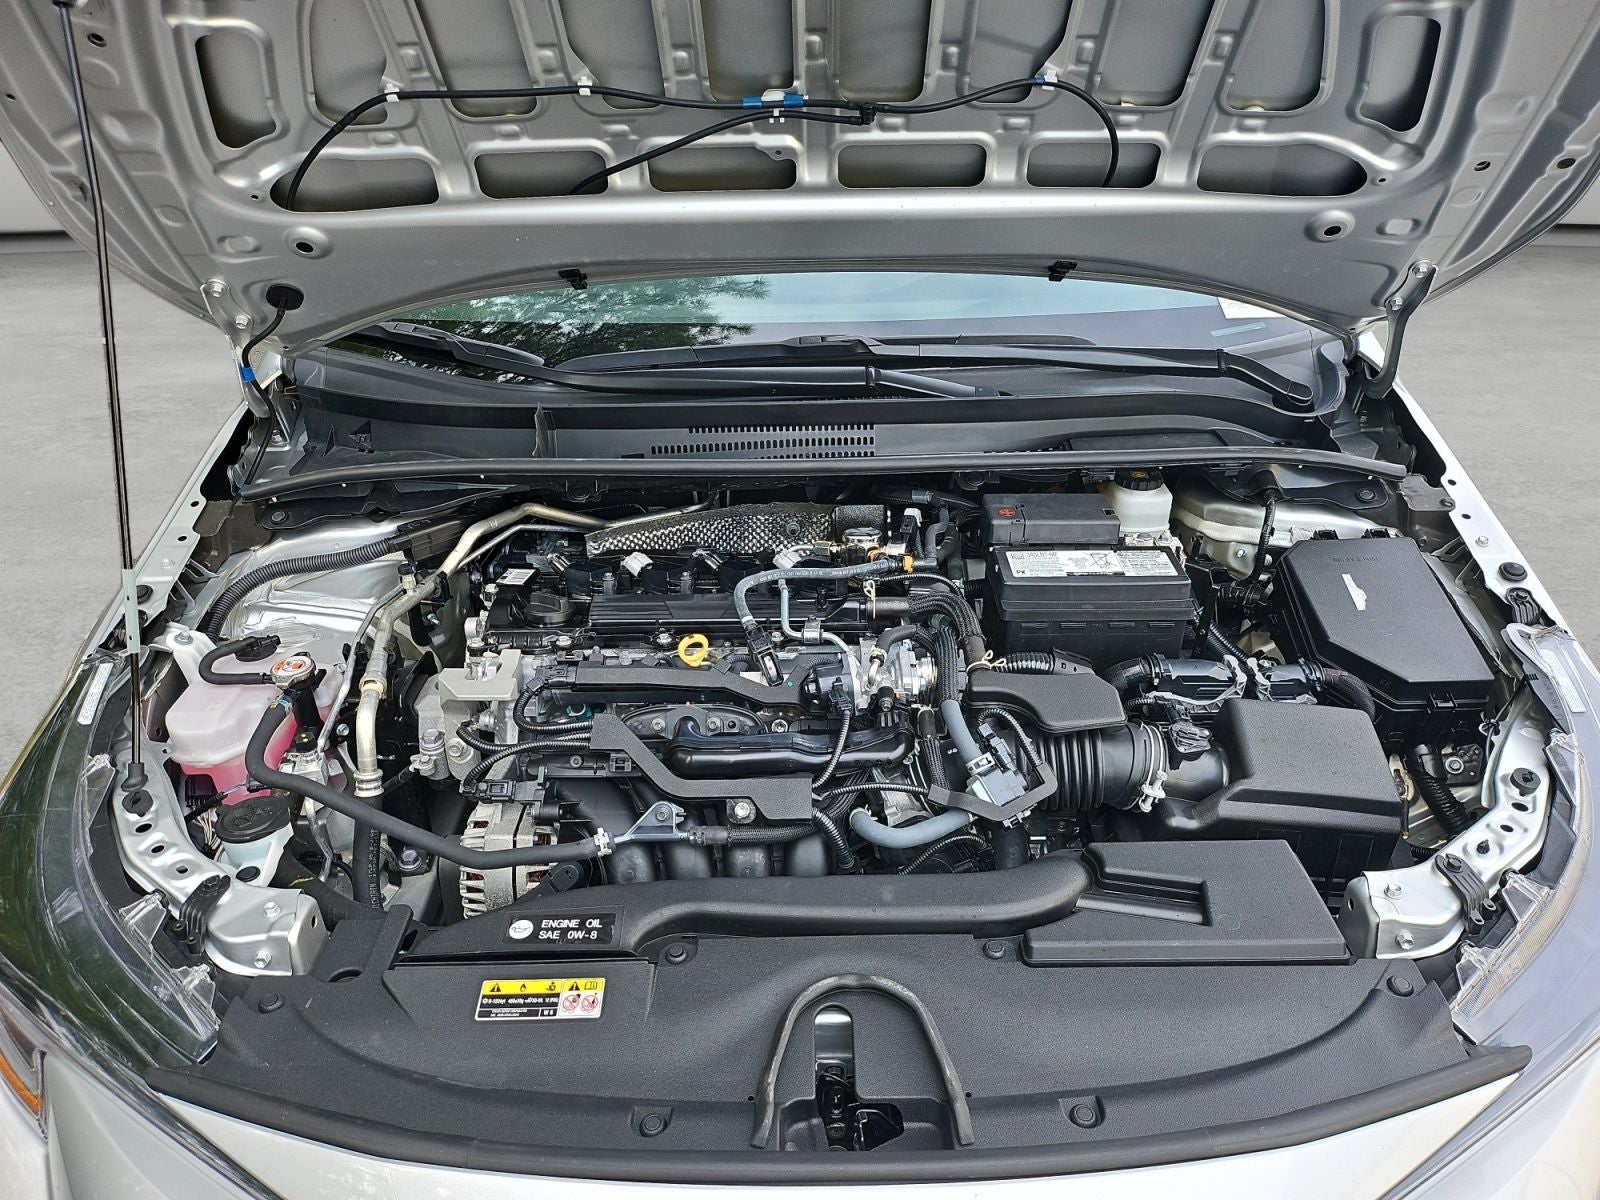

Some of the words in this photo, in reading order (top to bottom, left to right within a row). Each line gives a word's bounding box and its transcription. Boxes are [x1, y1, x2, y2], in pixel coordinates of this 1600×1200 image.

[541, 919, 580, 928] ENGINE
[585, 918, 603, 928] OIL
[538, 930, 561, 939] SAE
[567, 930, 598, 940] 0W-8
